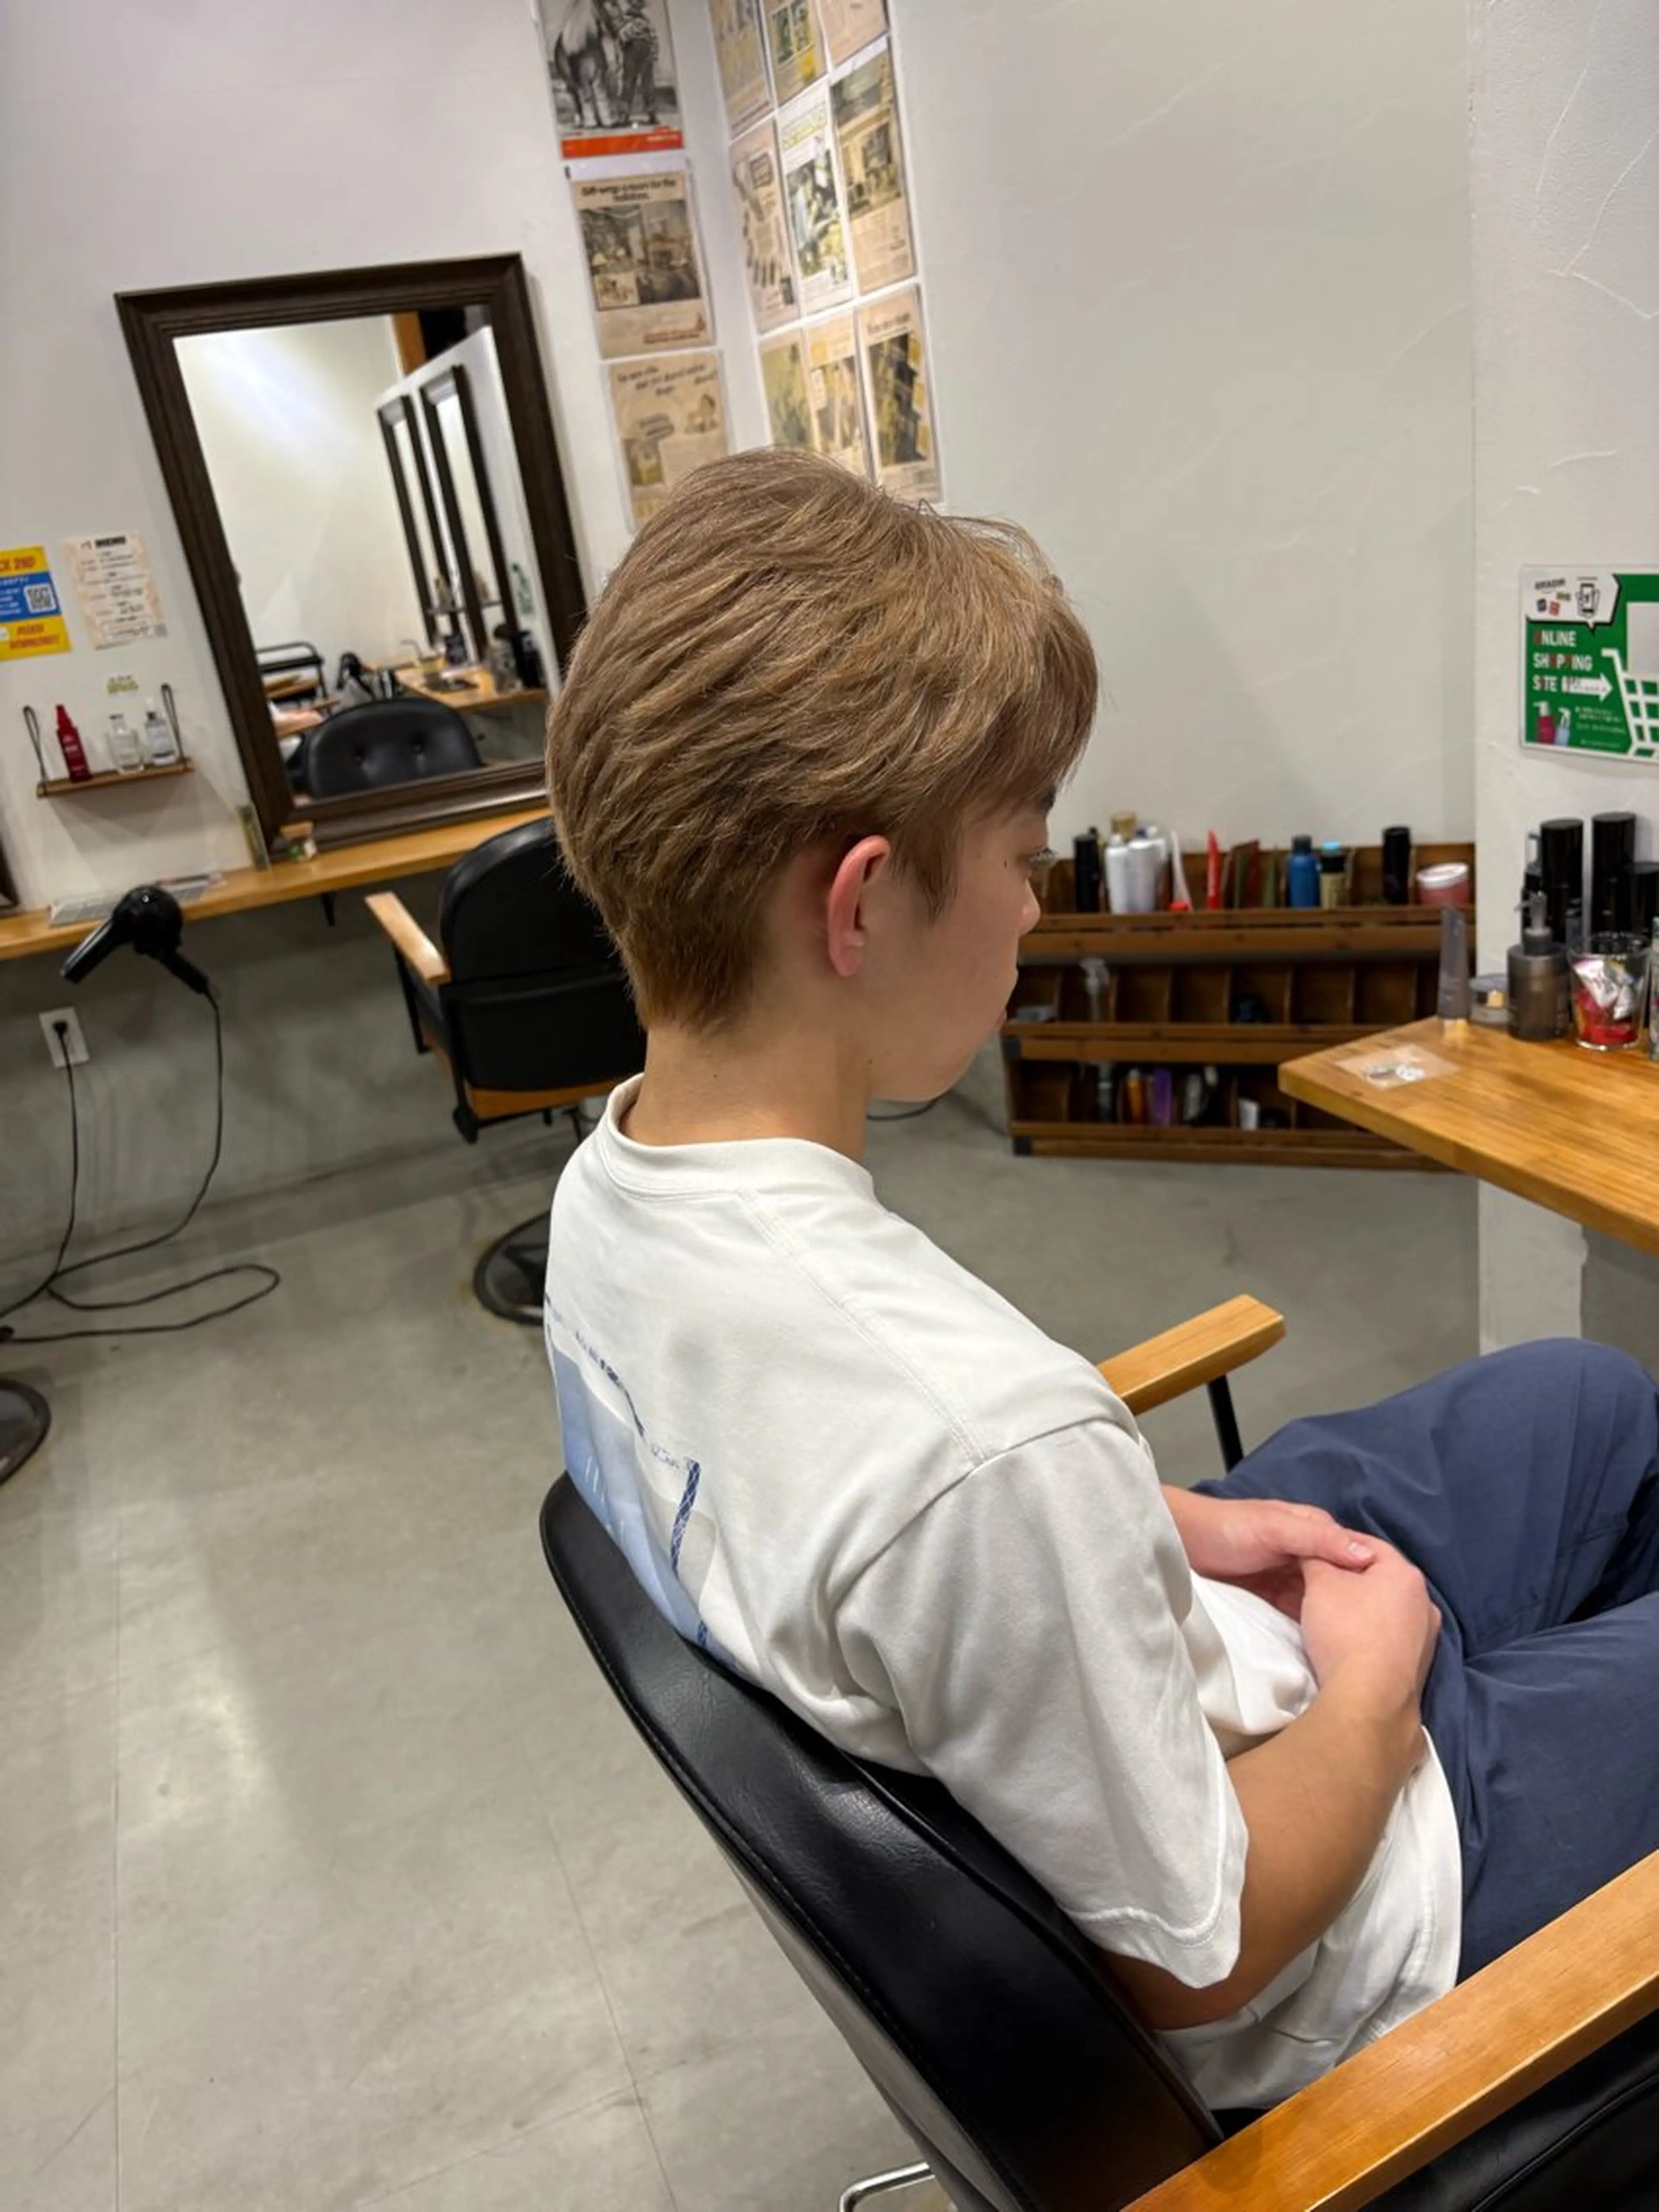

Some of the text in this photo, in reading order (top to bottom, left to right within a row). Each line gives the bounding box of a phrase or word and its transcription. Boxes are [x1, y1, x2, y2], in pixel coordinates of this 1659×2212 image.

[1534, 629, 1577, 647] ONLINE
[1533, 652, 1593, 672] SHOPPING
[1533, 674, 1558, 693] SITE
